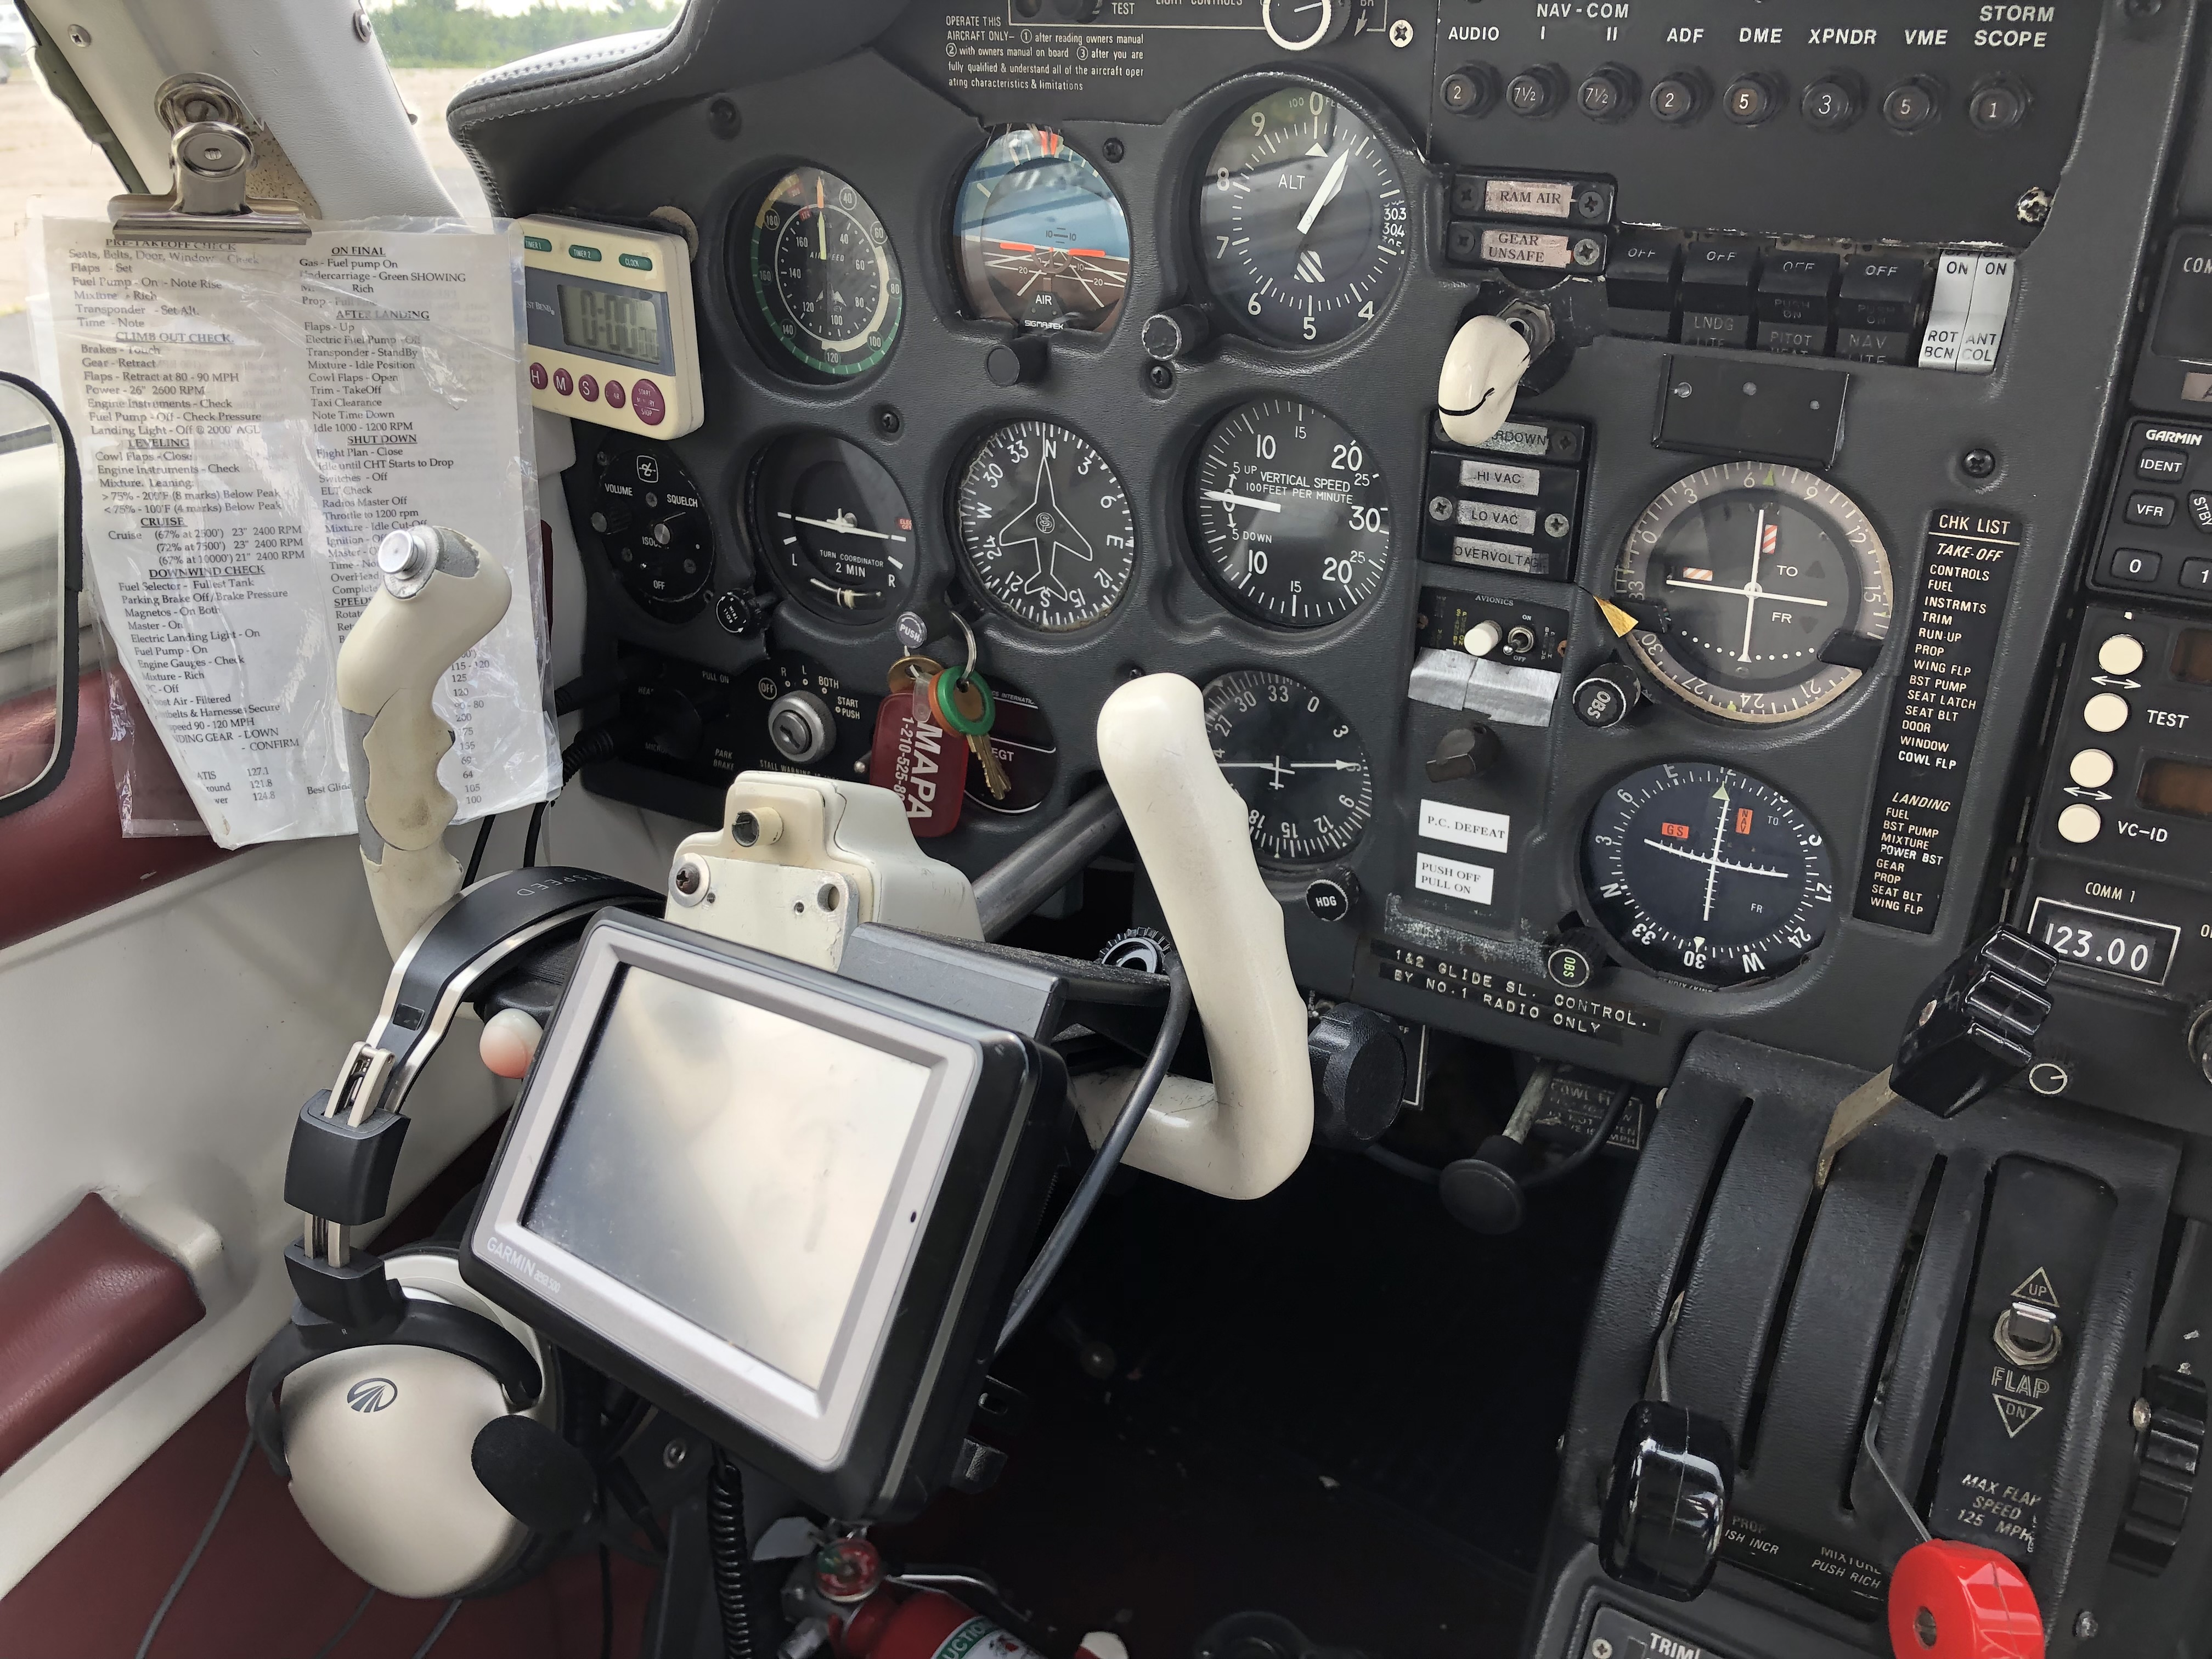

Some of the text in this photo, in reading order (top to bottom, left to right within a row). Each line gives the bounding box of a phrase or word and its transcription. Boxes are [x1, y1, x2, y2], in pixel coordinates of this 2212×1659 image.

[1112, 2, 1135, 15] TEST
[1980, 5, 2055, 22] STORM
[946, 15, 1001, 26] OPERATE THIS
[947, 31, 1143, 46] AIRCRAFT after reading owners manual
[1448, 26, 1499, 41] AUDIO
[1667, 27, 1704, 43] ADF
[1739, 28, 1782, 43] DME
[1808, 29, 1877, 46] XPNDR
[1905, 30, 1948, 46] VME
[1974, 30, 2047, 48] SCOPE
[960, 46, 975, 55] with
[1007, 47, 1032, 56] manual
[1048, 47, 1068, 58] board
[1278, 174, 1305, 189] ALT
[1500, 190, 1561, 204] RAM AIR
[1499, 233, 1538, 246] GEAR
[332, 247, 386, 256] ON FINAL
[1489, 247, 1544, 262] UNSAFE
[625, 258, 639, 267] CLOCK
[1946, 262, 1968, 275] ON
[1985, 262, 2006, 275] ON
[1035, 295, 1052, 305] AIR
[116, 332, 156, 342] CLIMB
[159, 332, 185, 342] OUT
[1927, 330, 1959, 345] ROT
[1965, 331, 1996, 346] ANT
[1924, 346, 1954, 359] BCN
[1962, 348, 1993, 362] COL
[311, 398, 332, 408] Taxi
[313, 410, 394, 420] Note Time Down
[128, 438, 190, 448] LEVELING
[347, 435, 417, 444] SHUT DOWN
[2146, 430, 2202, 446] GARMIN
[1244, 465, 1257, 475] UP
[2140, 459, 2182, 473] IDENT
[1261, 471, 1350, 493] VERTICAL SPEED
[1477, 472, 1521, 484] HI VAC
[321, 486, 372, 495] ELT Check
[605, 483, 633, 496] VOLUME
[1293, 489, 1353, 504] PER MINUTE
[322, 496, 407, 507] Radios Master Off
[667, 494, 698, 508] SQUELCH
[1472, 510, 1518, 524] LO VAC
[2137, 504, 2163, 517] VFR
[140, 517, 184, 527] CRUISE
[1939, 514, 2010, 535] CHK LIST
[109, 531, 142, 540] Cruise
[155, 530, 179, 540] (67%
[182, 530, 191, 538] at
[253, 526, 275, 535] 2400
[278, 526, 302, 534] RPM
[1243, 531, 1272, 544] DOWN
[820, 550, 884, 568] TURN COORDINATOR
[1937, 543, 2004, 562] TAKE-OFF
[149, 565, 265, 579] DOWNWIND CHECK
[836, 563, 866, 578] 2 MIN
[1929, 565, 1989, 581] CONTROLS
[1928, 580, 1953, 592] FUEL
[1475, 595, 1514, 606] AVIONICS
[1924, 596, 1987, 614] INSTRMTS
[1922, 612, 1952, 625] TRIM
[899, 623, 921, 641] PUSH
[1918, 628, 1962, 642] RUN-UP
[1915, 644, 1944, 657] PROP
[1914, 659, 1971, 676] WING FLP
[819, 675, 839, 689] BOTH
[1909, 675, 1966, 692] BST PUMP
[837, 696, 859, 708] START
[1587, 691, 1611, 719] OBS
[1907, 690, 1976, 710] SEAT LATCH
[842, 708, 860, 719] PUSH
[1905, 706, 1958, 721] SEAT BLT
[2147, 709, 2189, 728] TEST
[1902, 720, 1931, 733] DOOR
[1900, 736, 1949, 752] WINDOW
[1898, 751, 1956, 770] COWL FLP
[247, 767, 269, 777] 127.1
[906, 723, 943, 818] MAPA
[250, 779, 272, 789] 121.8
[253, 791, 275, 801] 124.8
[1892, 792, 1951, 812] LANDING
[1886, 808, 1909, 820] FUEL
[1427, 815, 1505, 839] P.C. DEFEAT
[1883, 820, 1939, 838] BST PUMP
[2117, 821, 2168, 843] VC-ID
[1881, 833, 1929, 850] MIXTURE
[1880, 844, 1943, 865] POWER BST
[1422, 862, 1481, 883] PUSH OFF
[1876, 859, 1904, 872] GEAR
[1421, 876, 1470, 894] PULL ON
[1874, 872, 1901, 884] PROP
[1872, 884, 1922, 902] SEAT BLT
[2085, 882, 2136, 903] COMM 1
[1316, 896, 1336, 907] HDG
[1871, 897, 1923, 915] WING FLP
[1438, 962, 1492, 988] GLIDE
[1506, 981, 1536, 997] SL.
[1394, 969, 1414, 983] BY
[1483, 993, 1538, 1018] RADIO
[1553, 1013, 1600, 1033] ONLY
[487, 1237, 536, 1277] GARMIN
[2029, 1283, 2046, 1297] UP
[1991, 1366, 2050, 1399] FLAP
[2006, 1404, 2026, 1419] DN
[1962, 1474, 2041, 1508] MAX FLAP
[1972, 1496, 2021, 1520] SPEED
[1957, 1508, 1983, 1526] 125
[1812, 1559, 1881, 1589] PUSH RICH
